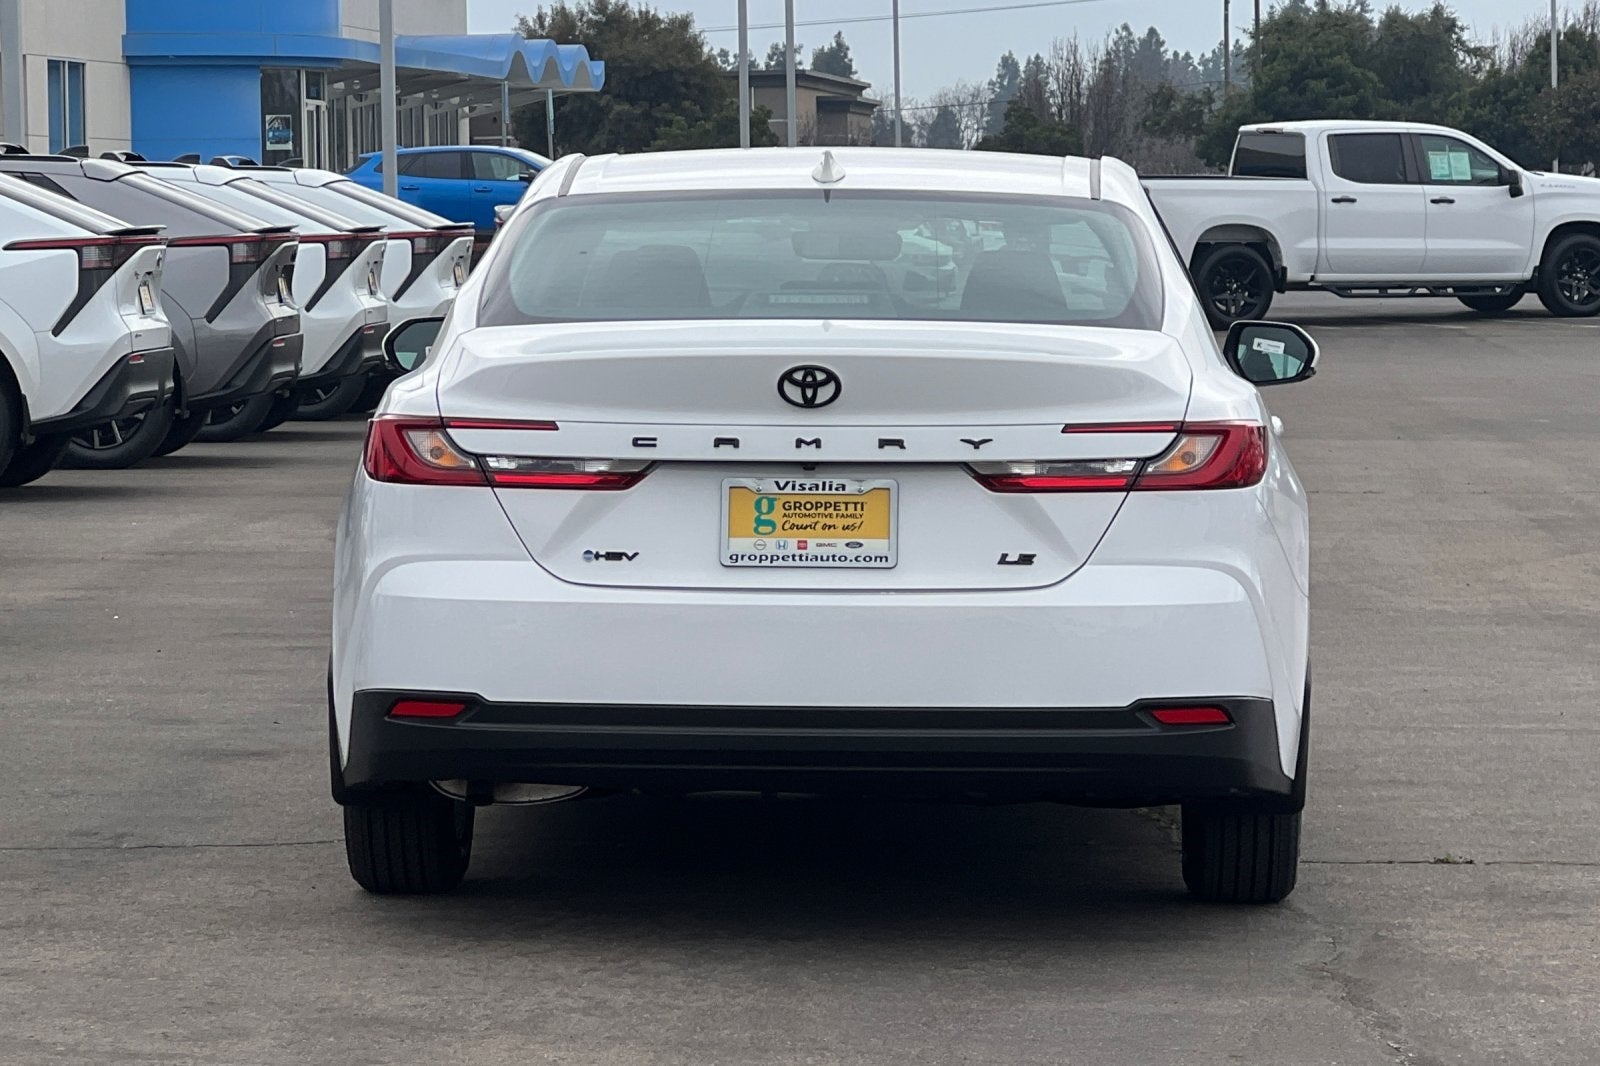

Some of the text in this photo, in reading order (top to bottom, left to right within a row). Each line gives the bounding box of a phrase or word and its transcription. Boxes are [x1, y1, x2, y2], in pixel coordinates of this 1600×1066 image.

[632, 437, 993, 450] CAMRY
[774, 480, 847, 492] Visalia
[782, 501, 864, 511] GROPPETTI
[753, 496, 778, 535] g
[782, 520, 820, 531] Count
[841, 520, 864, 531] us!
[729, 553, 889, 564] groppettiauto.com
[997, 553, 1037, 565] LE
